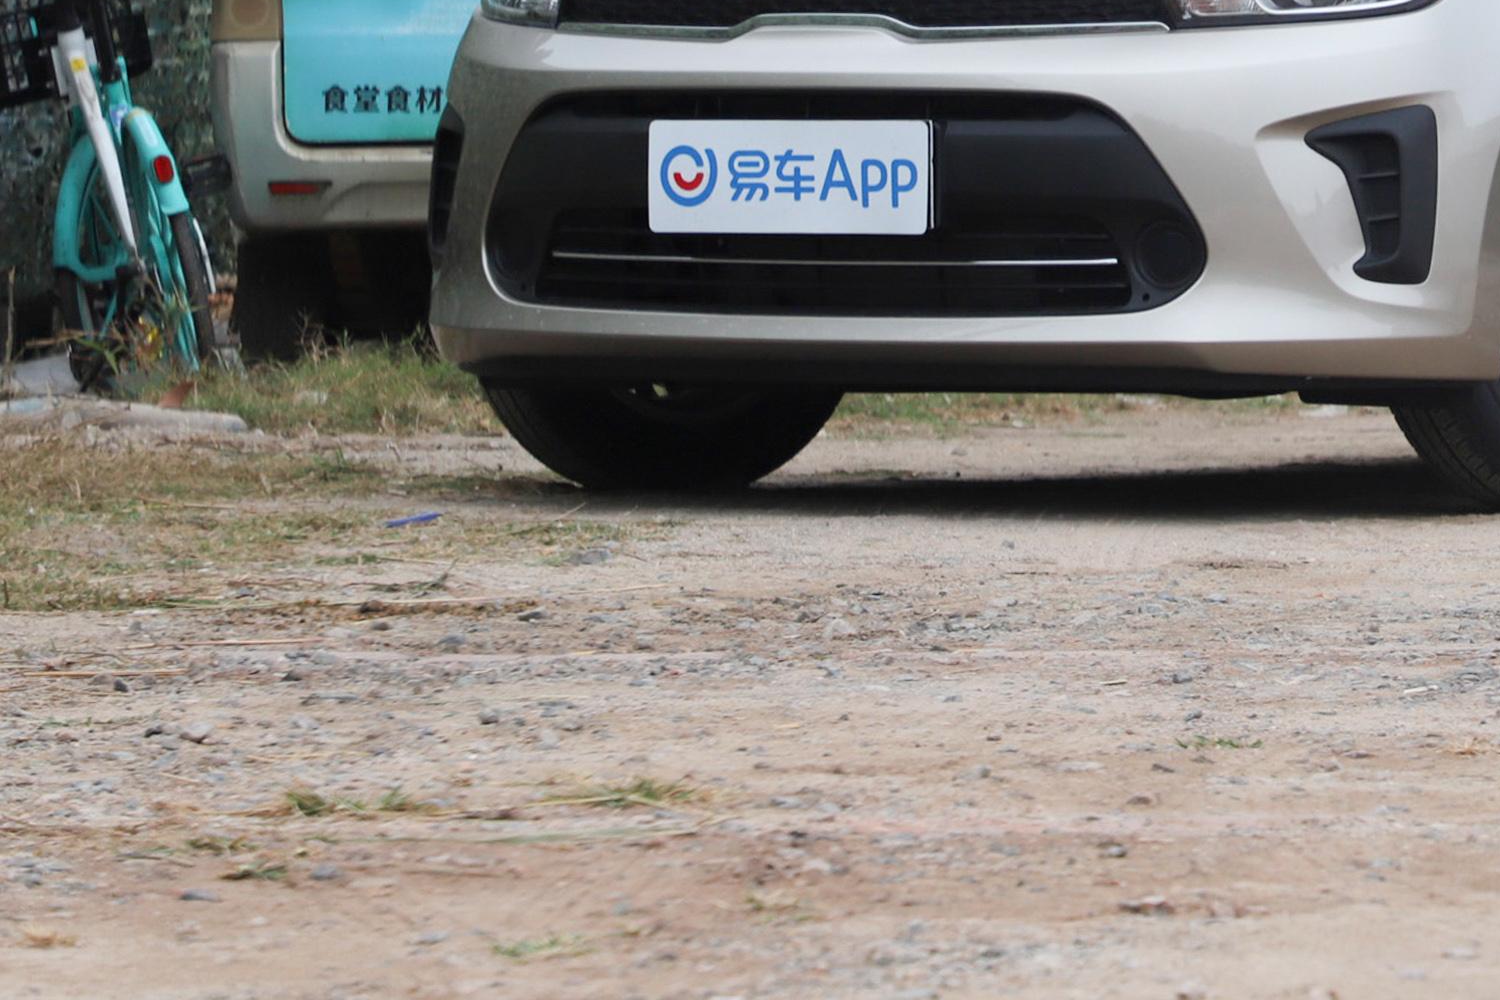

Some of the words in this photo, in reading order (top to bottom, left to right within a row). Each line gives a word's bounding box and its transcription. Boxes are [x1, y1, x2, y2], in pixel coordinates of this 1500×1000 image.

[322, 84, 443, 114] 食堂食材
[727, 148, 918, 209] 易车App
